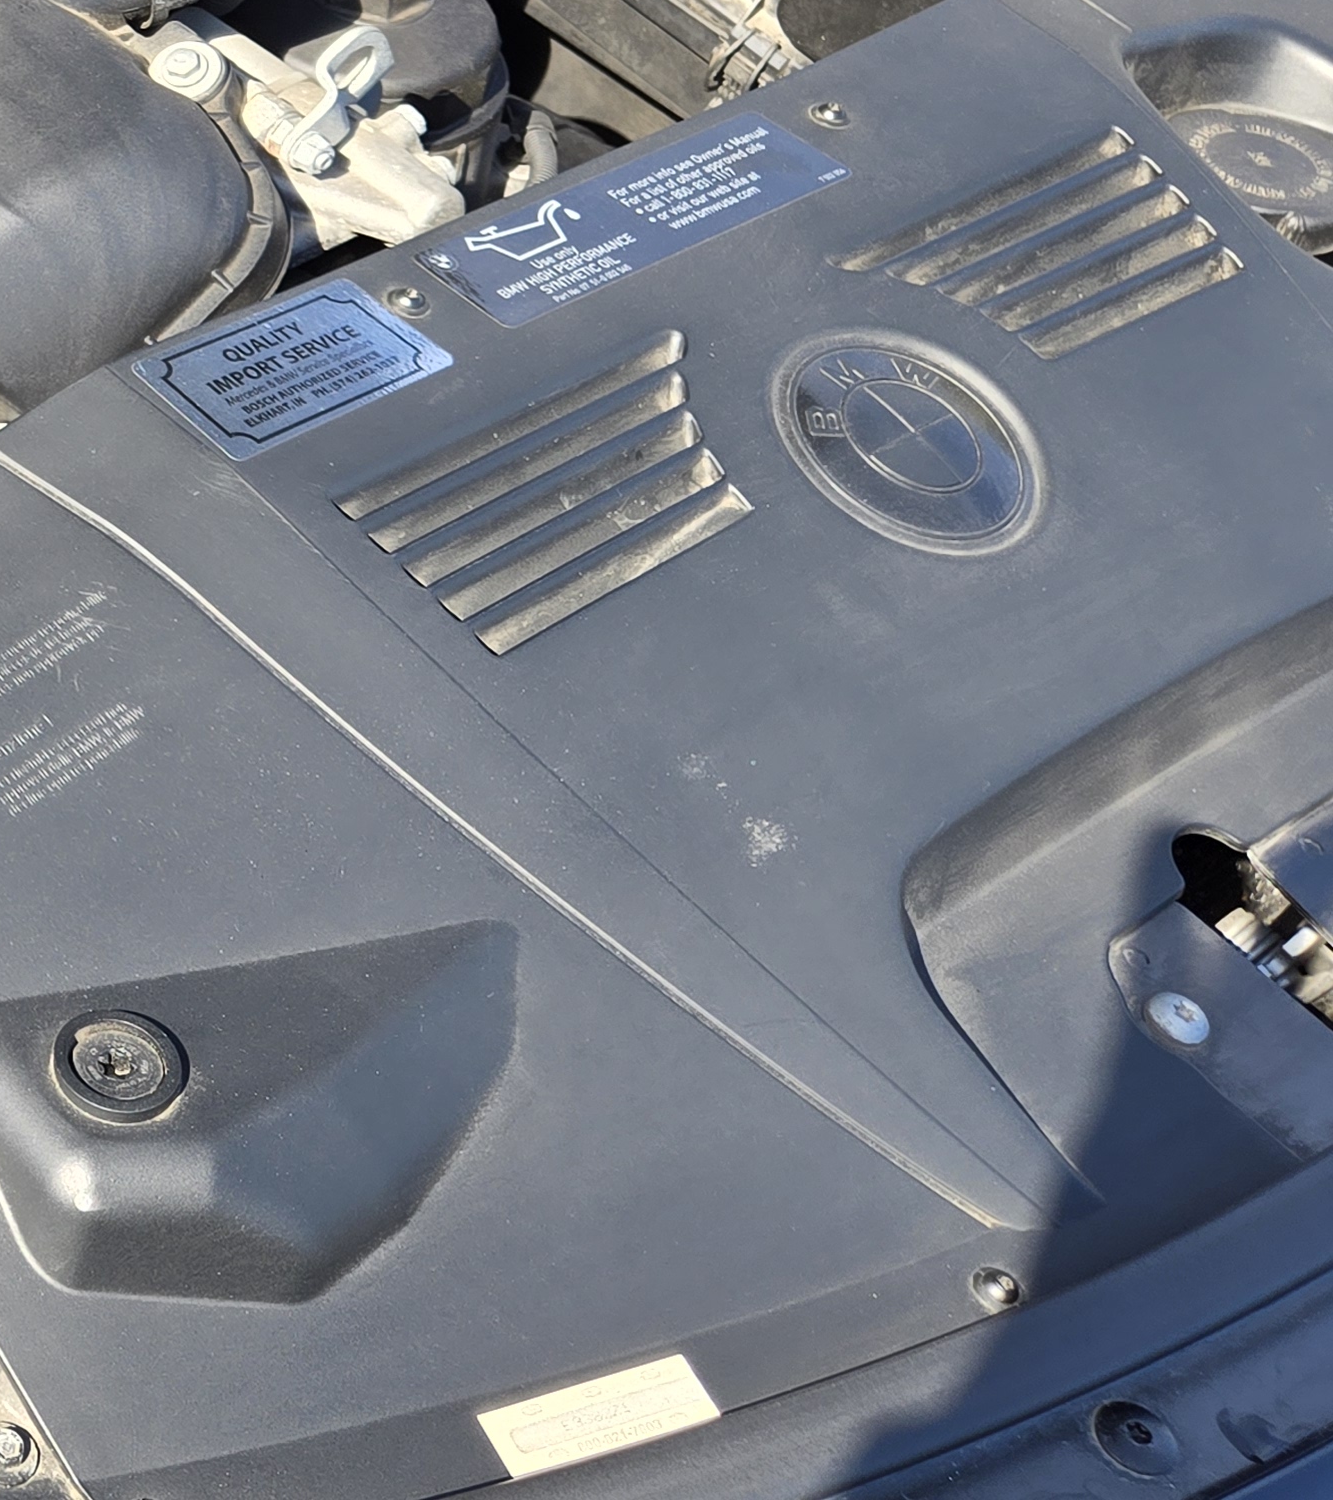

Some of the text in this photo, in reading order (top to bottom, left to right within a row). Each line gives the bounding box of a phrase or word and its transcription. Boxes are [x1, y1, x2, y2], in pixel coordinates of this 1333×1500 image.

[606, 186, 629, 199] For
[627, 175, 657, 191] more
[651, 167, 676, 180] info
[673, 159, 694, 171] see
[728, 126, 769, 146] Manual
[619, 142, 766, 207] For a list of other approved oils
[643, 198, 665, 212] call
[656, 170, 761, 220] or visit our web site at
[668, 186, 760, 229] www.bmwusa.com
[496, 232, 636, 298] BMW HIGH PERFORMANCE
[529, 245, 579, 269] Use only
[539, 255, 621, 294] SYNTHETIC OIL
[206, 324, 360, 395] IMPORT SERVICE
[221, 321, 302, 362] QUALITY
[240, 350, 381, 414] BOSCH AUTHORIZED SERVICE
[272, 370, 299, 385] BMW
